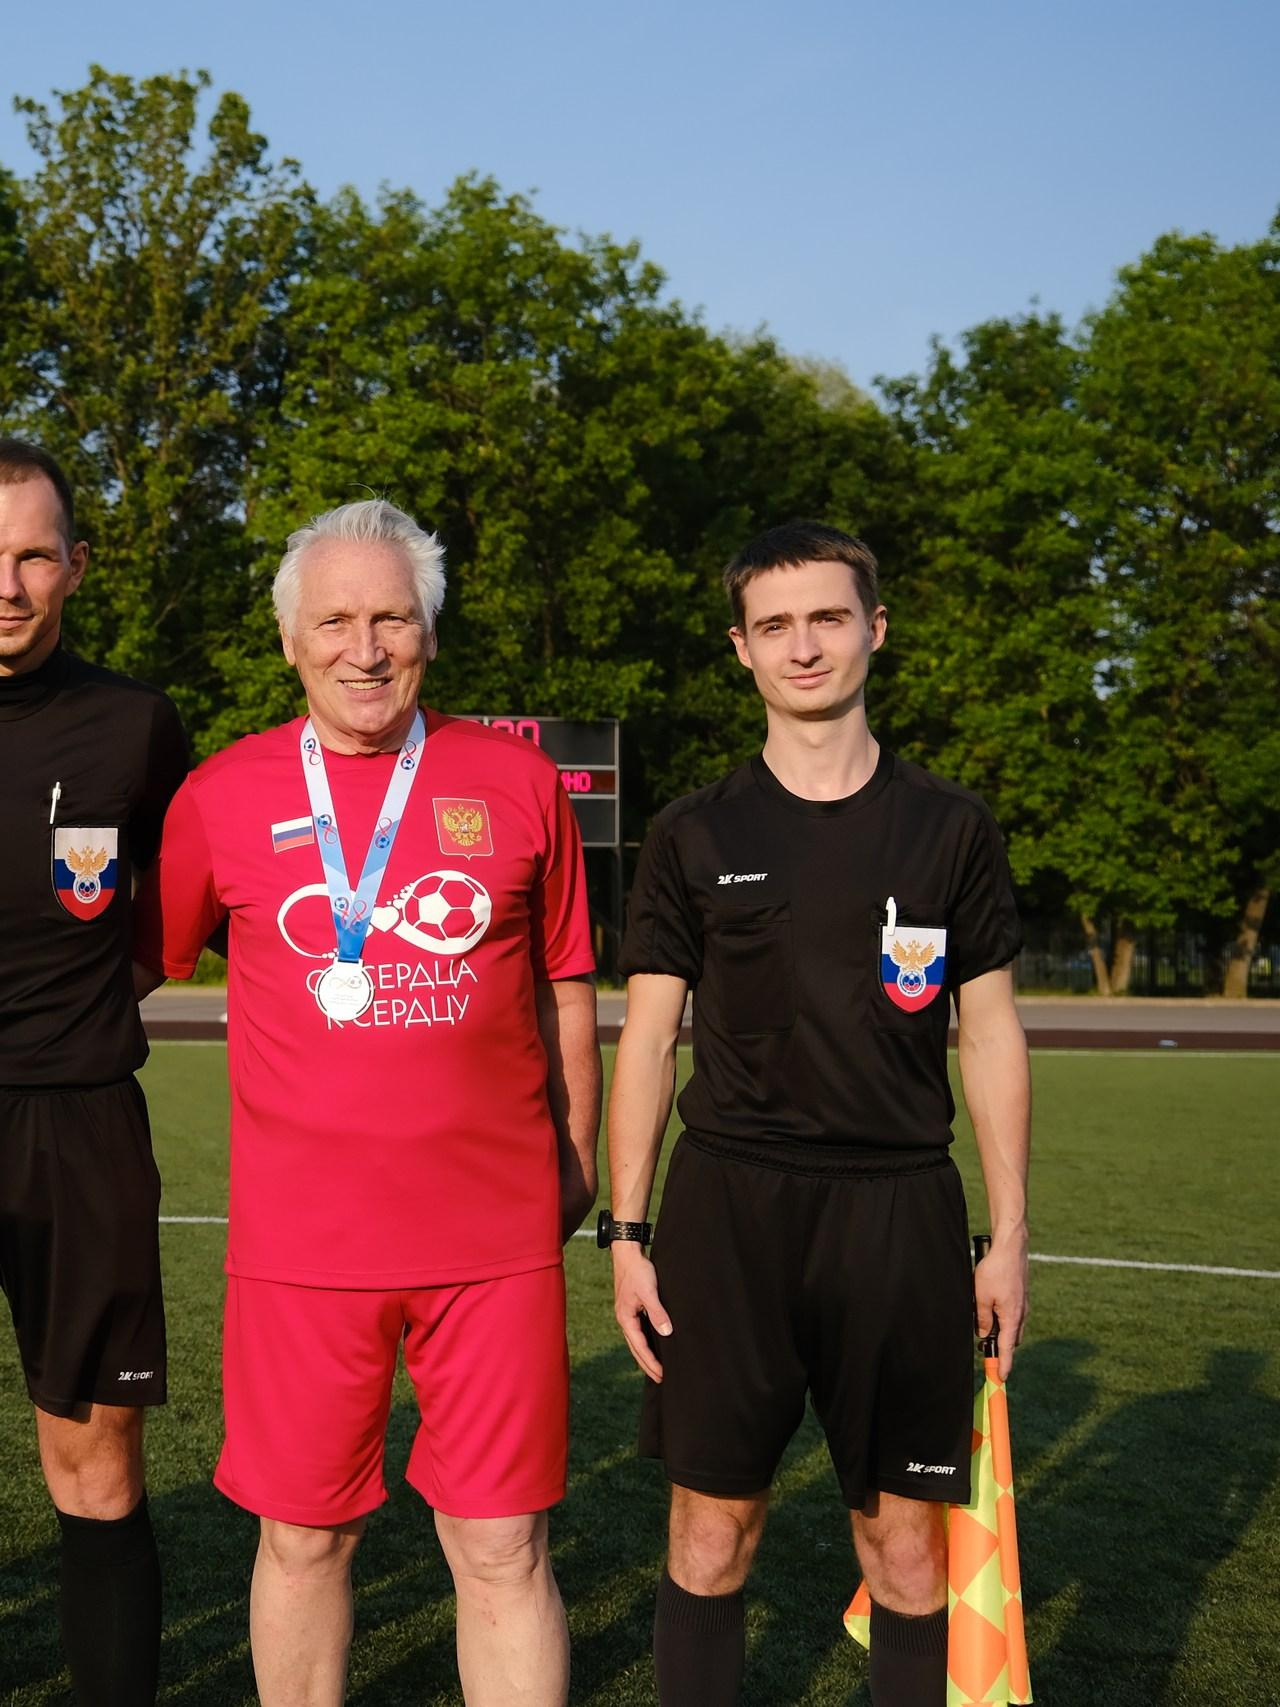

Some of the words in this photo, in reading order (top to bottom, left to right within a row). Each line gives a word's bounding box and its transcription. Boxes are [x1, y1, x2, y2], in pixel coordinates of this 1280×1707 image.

[717, 873, 735, 885] 2K
[733, 873, 768, 883] SPORT
[923, 1465, 957, 1475] SPORT
